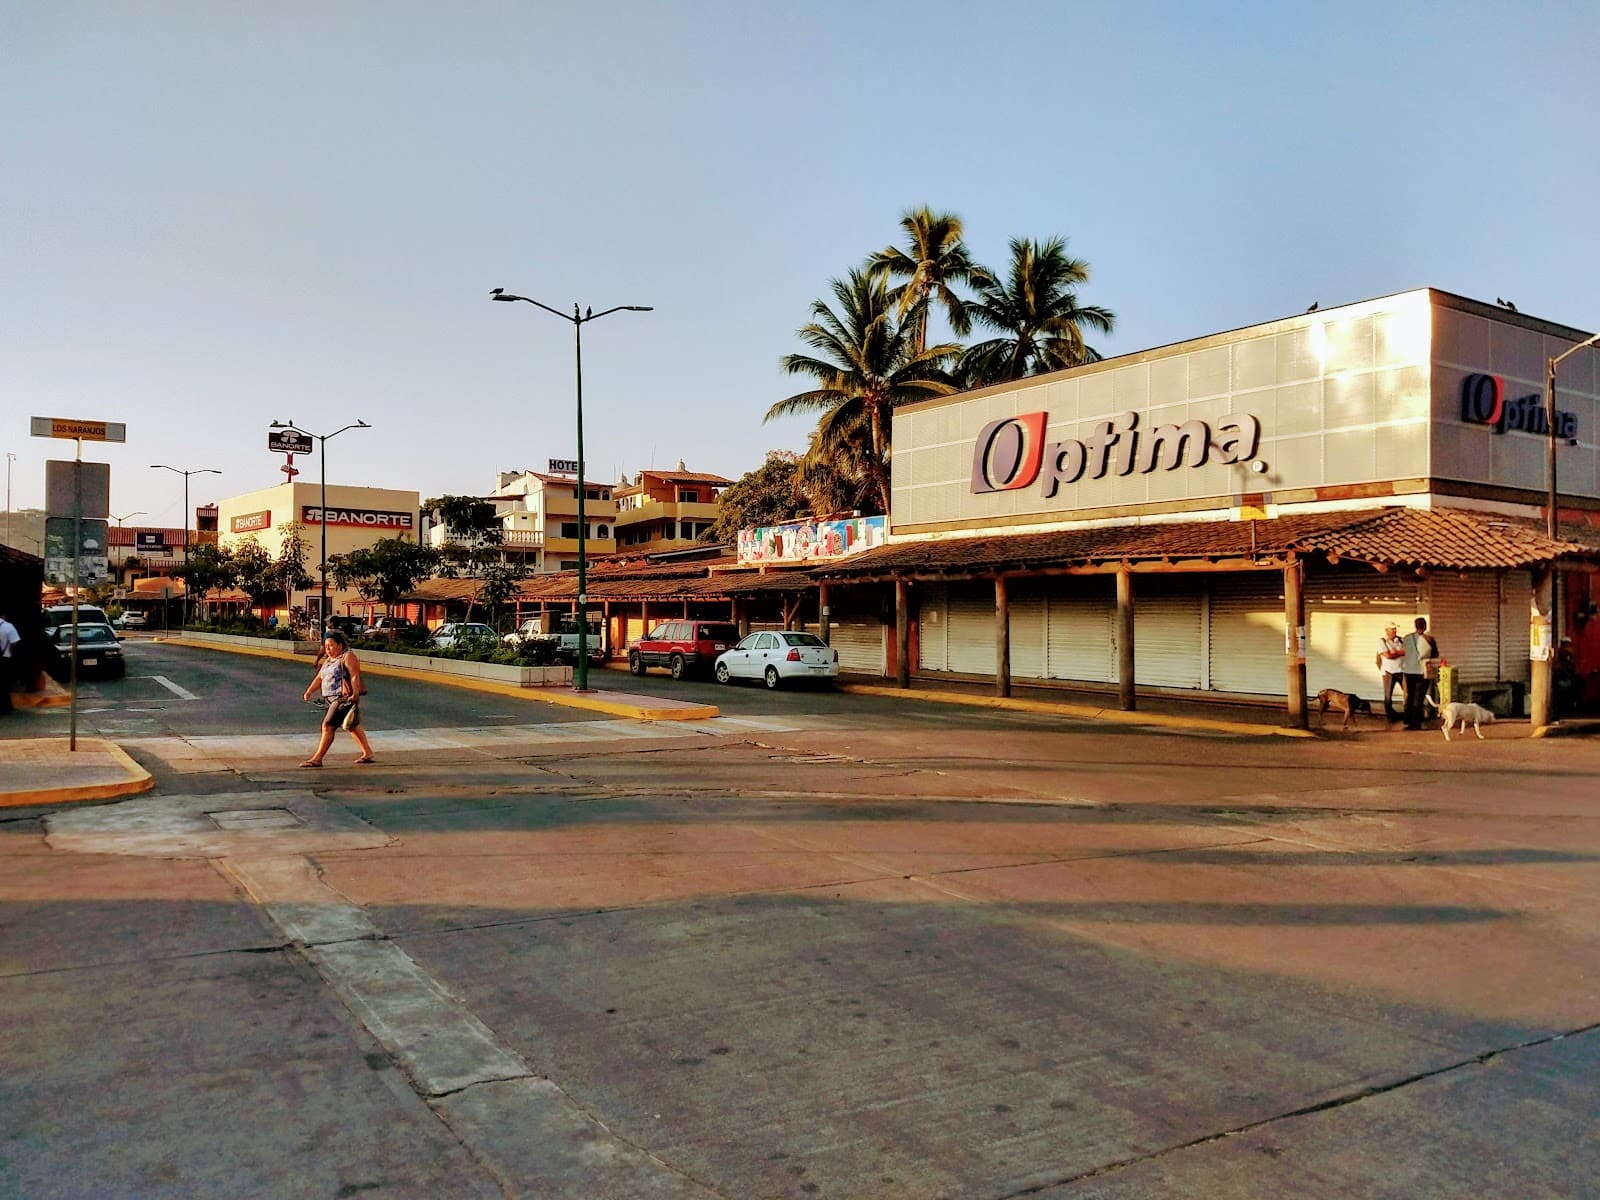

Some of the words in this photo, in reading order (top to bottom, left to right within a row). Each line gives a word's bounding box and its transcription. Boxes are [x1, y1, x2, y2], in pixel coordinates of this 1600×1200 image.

[52, 423, 67, 433] LOS
[68, 424, 105, 435] NARANJOS
[270, 441, 311, 451] BANORTE
[970, 411, 1261, 498] Optima
[549, 460, 579, 471] HOTE
[325, 511, 411, 526] BANORTE
